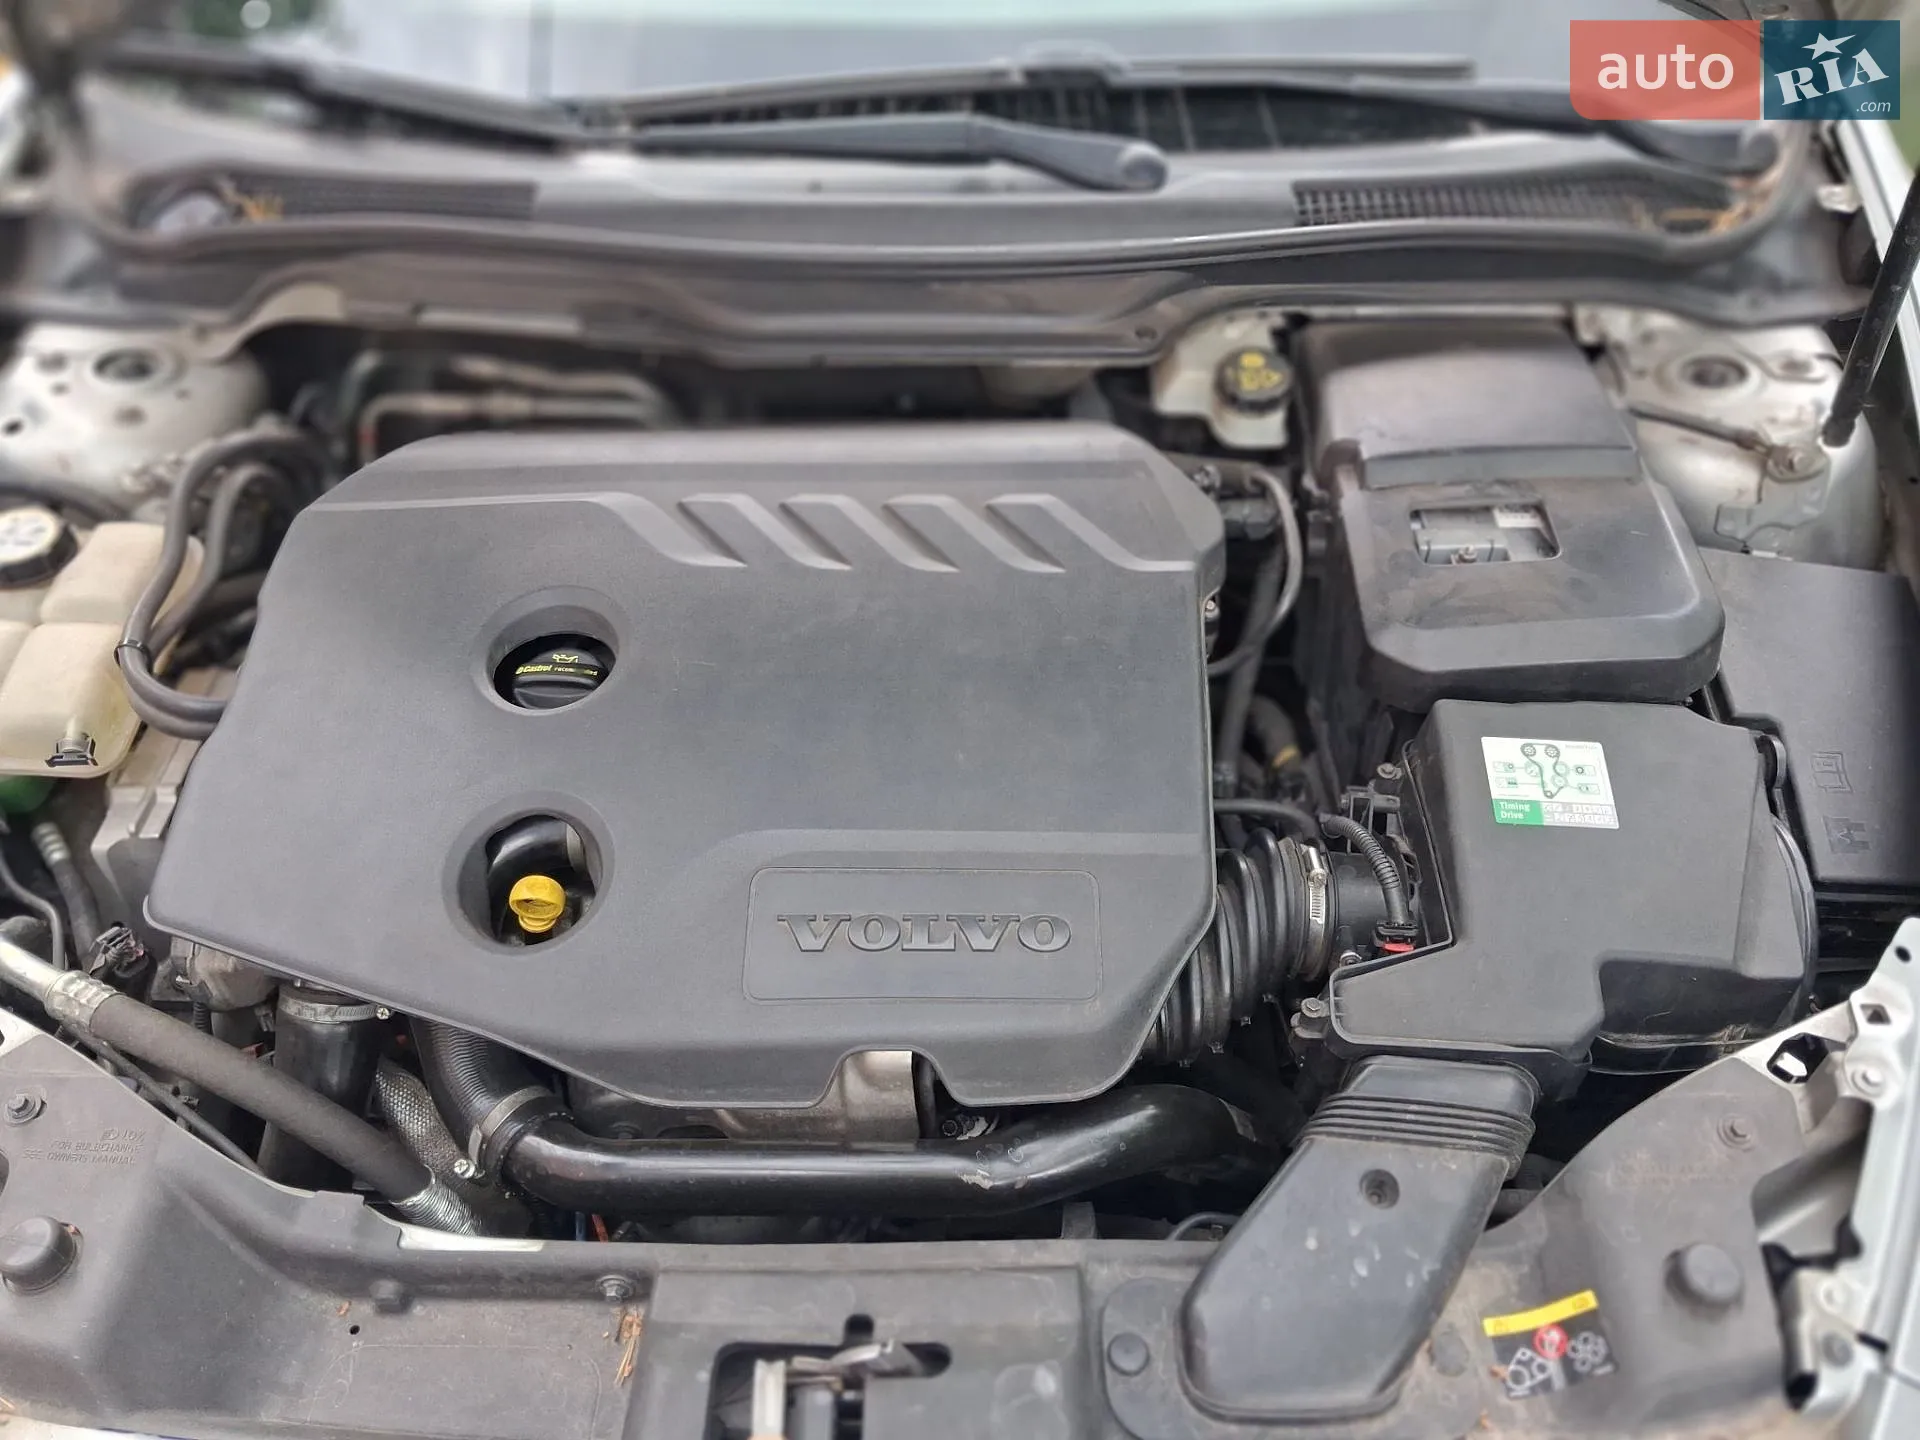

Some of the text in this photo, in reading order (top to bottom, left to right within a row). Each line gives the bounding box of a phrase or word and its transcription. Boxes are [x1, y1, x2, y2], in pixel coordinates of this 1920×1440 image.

[1499, 801, 1531, 813] Timing
[1500, 811, 1524, 820] Drive
[777, 914, 1072, 952] VOLVO
